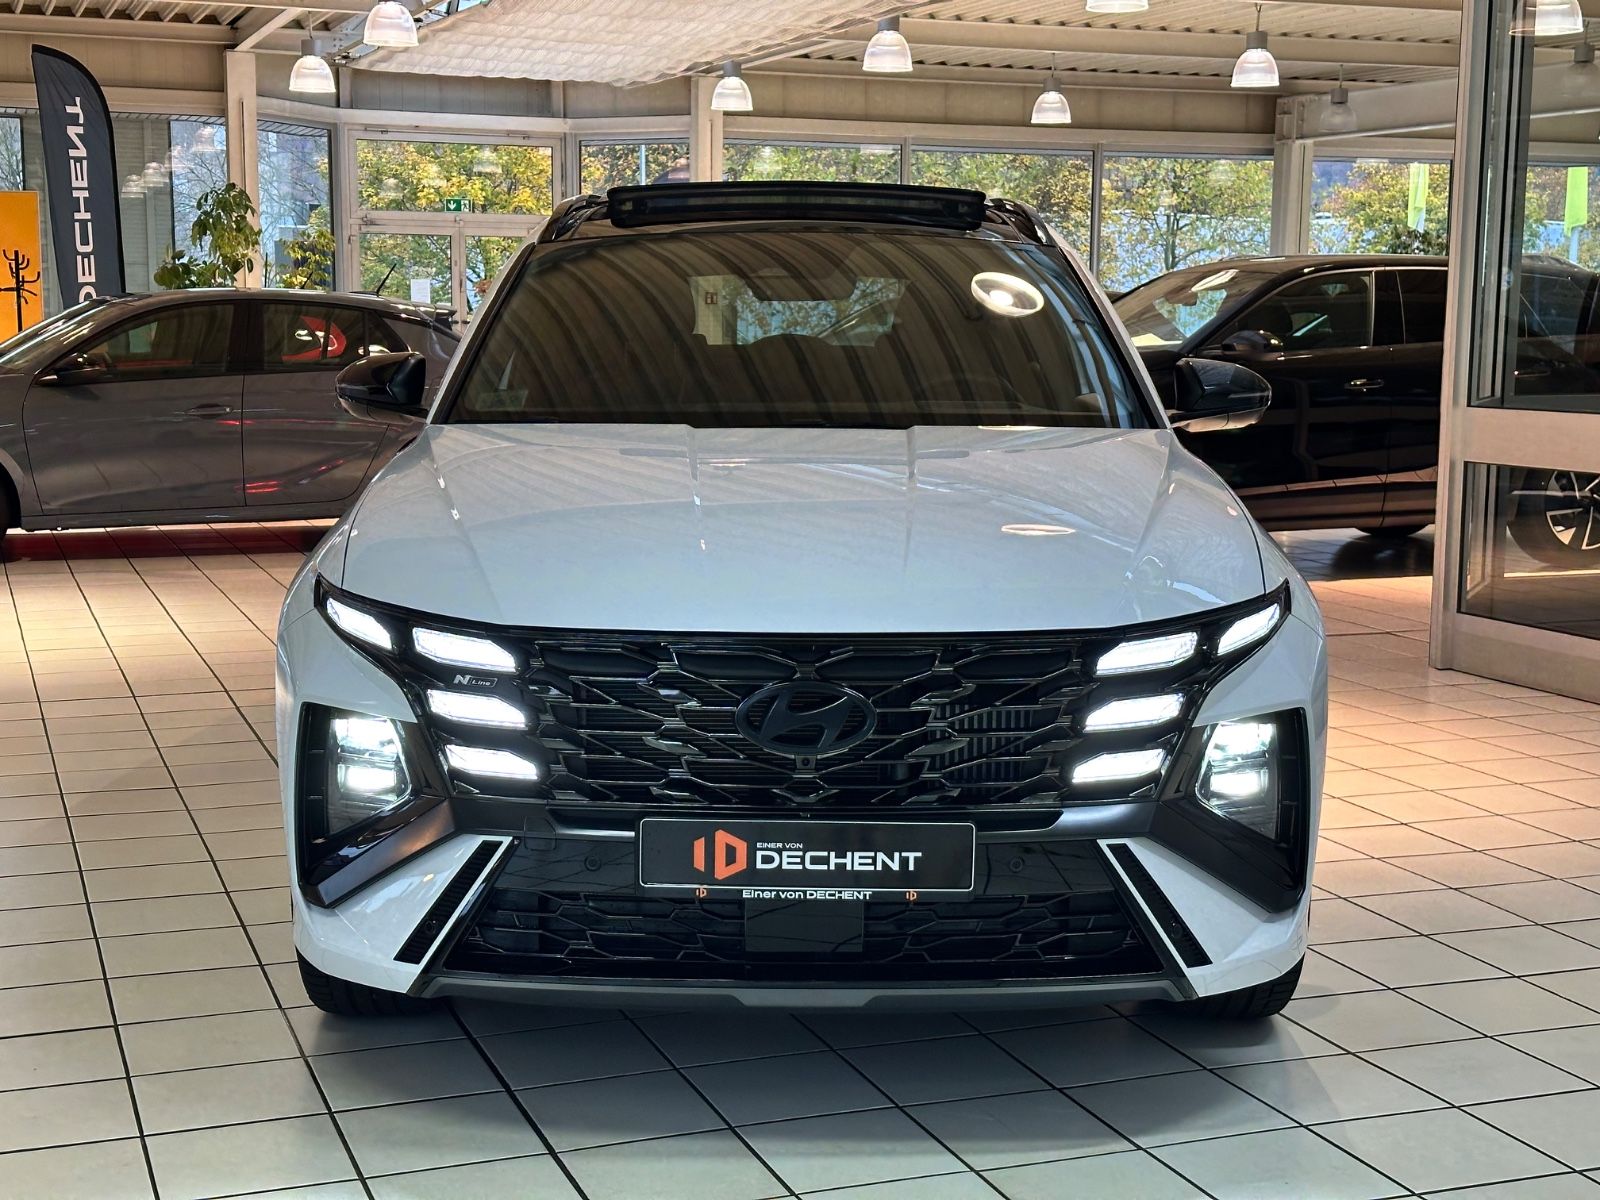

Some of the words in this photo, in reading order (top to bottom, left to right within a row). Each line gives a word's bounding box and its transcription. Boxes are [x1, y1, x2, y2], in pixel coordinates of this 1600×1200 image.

[453, 674, 471, 686] N
[755, 850, 922, 871] DECHENT
[779, 891, 804, 899] von
[806, 890, 873, 900] DECHENT
